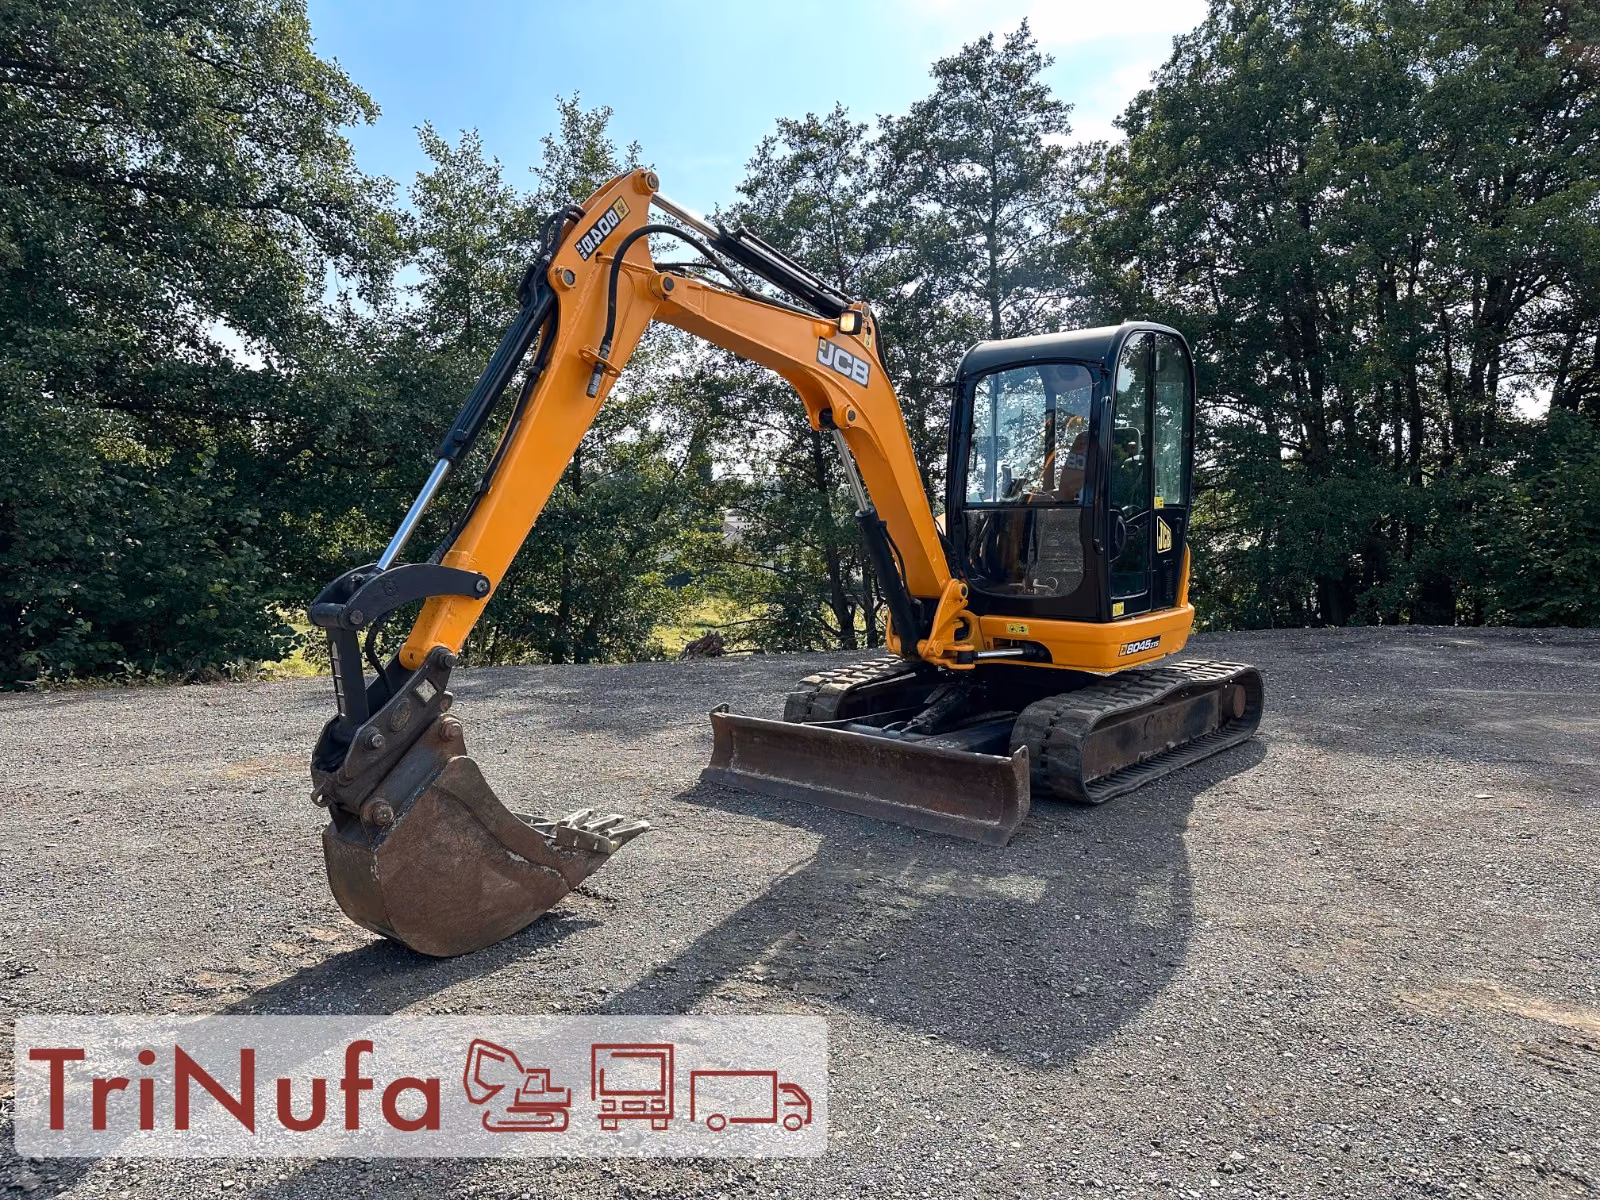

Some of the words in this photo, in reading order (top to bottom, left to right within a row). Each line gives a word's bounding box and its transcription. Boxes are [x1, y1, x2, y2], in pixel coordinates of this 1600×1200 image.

[581, 208, 619, 254] 8045
[817, 343, 869, 386] JCB
[1158, 520, 1171, 550] JCB
